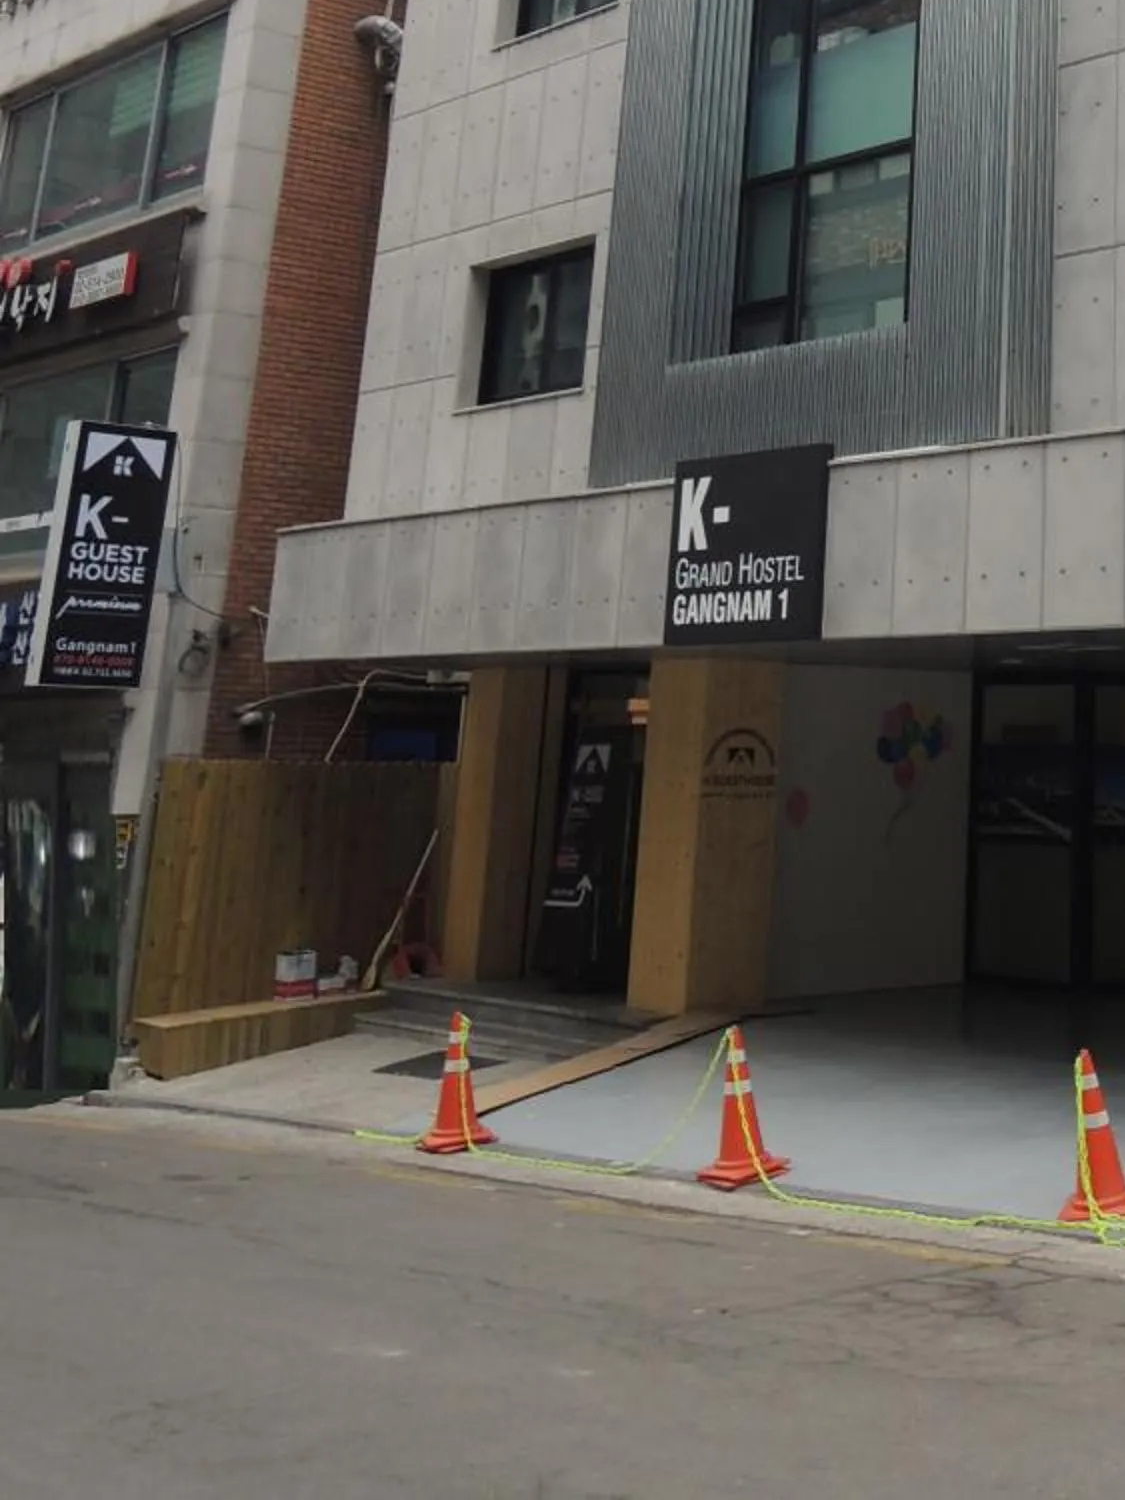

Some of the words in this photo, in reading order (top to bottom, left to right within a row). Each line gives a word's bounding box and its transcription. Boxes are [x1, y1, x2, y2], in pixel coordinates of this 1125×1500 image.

[75, 493, 129, 539] K-
[677, 476, 731, 553] K-
[70, 541, 149, 566] GUEST
[675, 557, 733, 589] GRAND
[738, 552, 805, 584] HOSTEL
[67, 562, 146, 585] HOUSE
[673, 589, 772, 626] GANGNAM
[778, 587, 789, 620] 1
